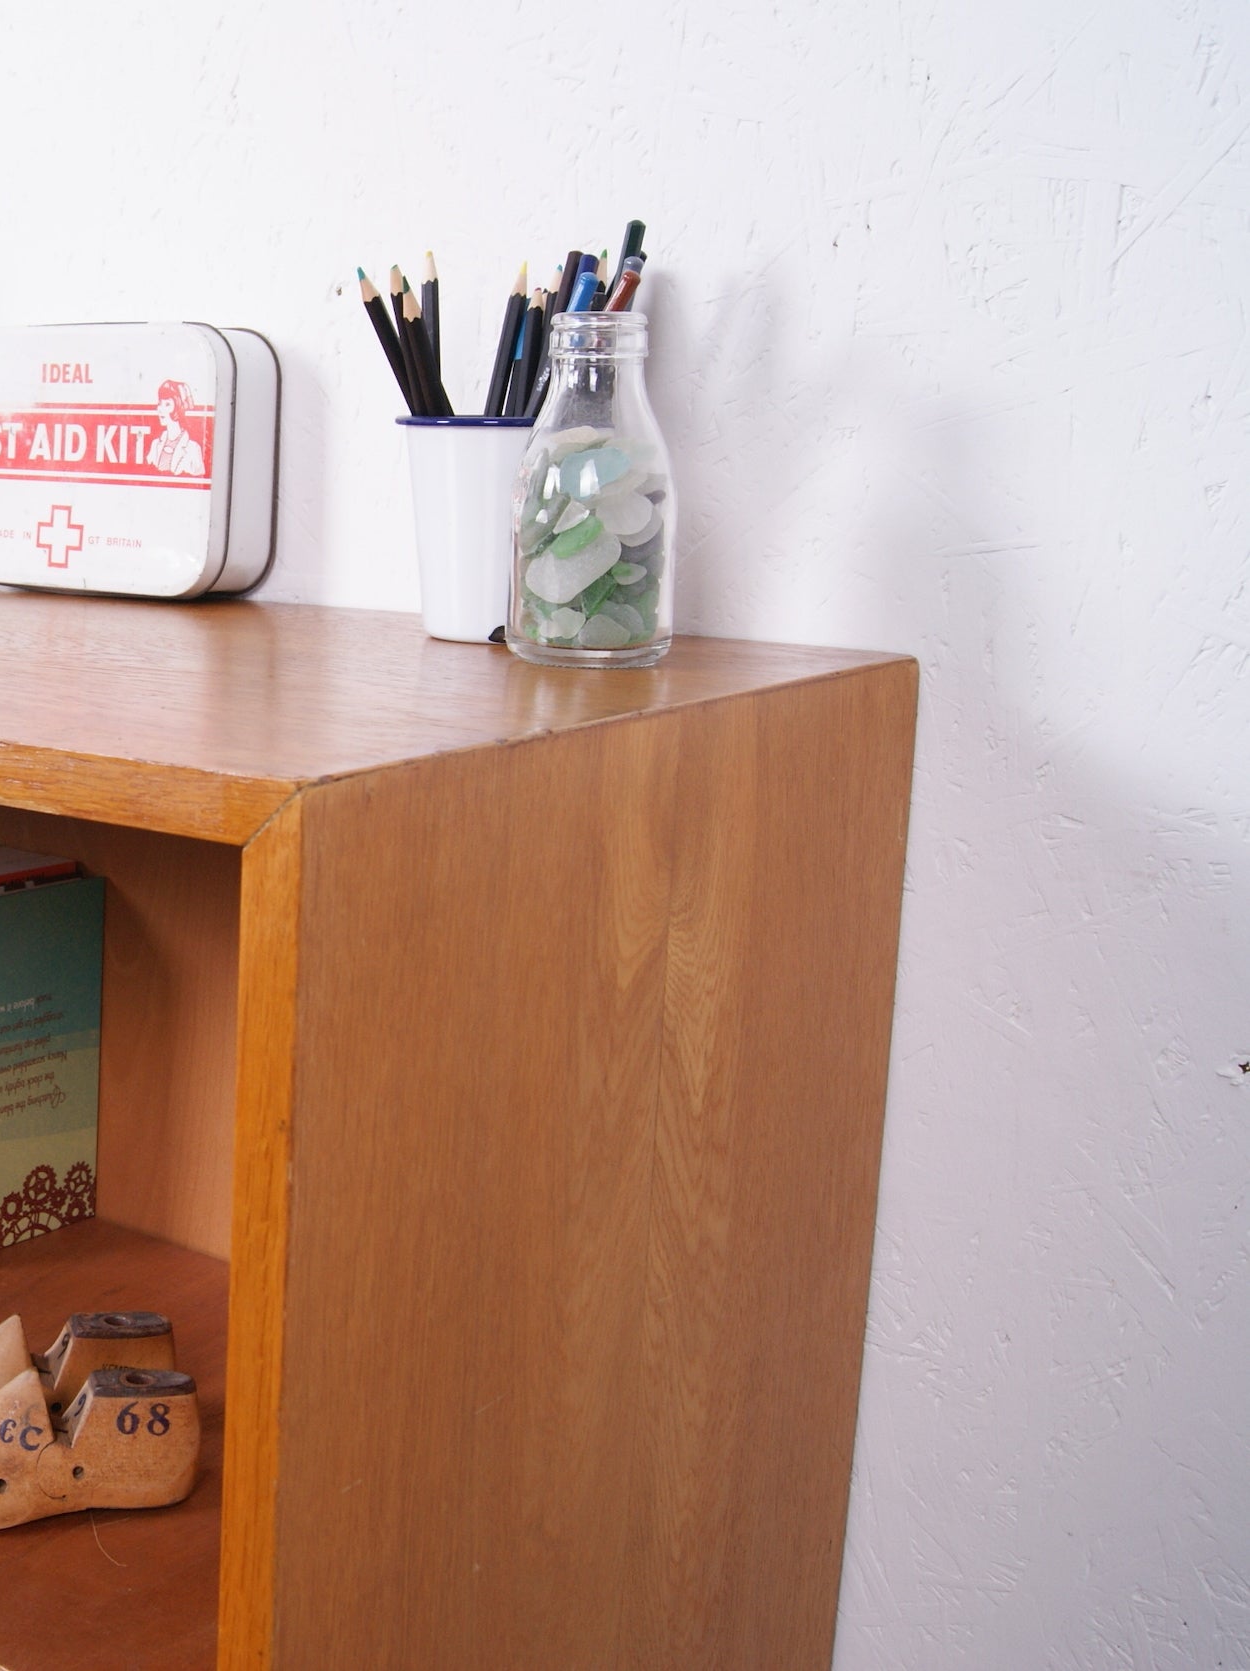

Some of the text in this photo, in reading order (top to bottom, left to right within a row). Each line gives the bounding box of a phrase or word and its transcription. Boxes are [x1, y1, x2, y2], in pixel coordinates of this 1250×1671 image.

[42, 363, 94, 384] IDEAL
[28, 423, 87, 462] AID
[96, 425, 151, 465] KIT
[23, 531, 31, 540] IN
[88, 536, 100, 545] GT
[107, 537, 142, 548] BRITAIN
[116, 1401, 171, 1436] 68
